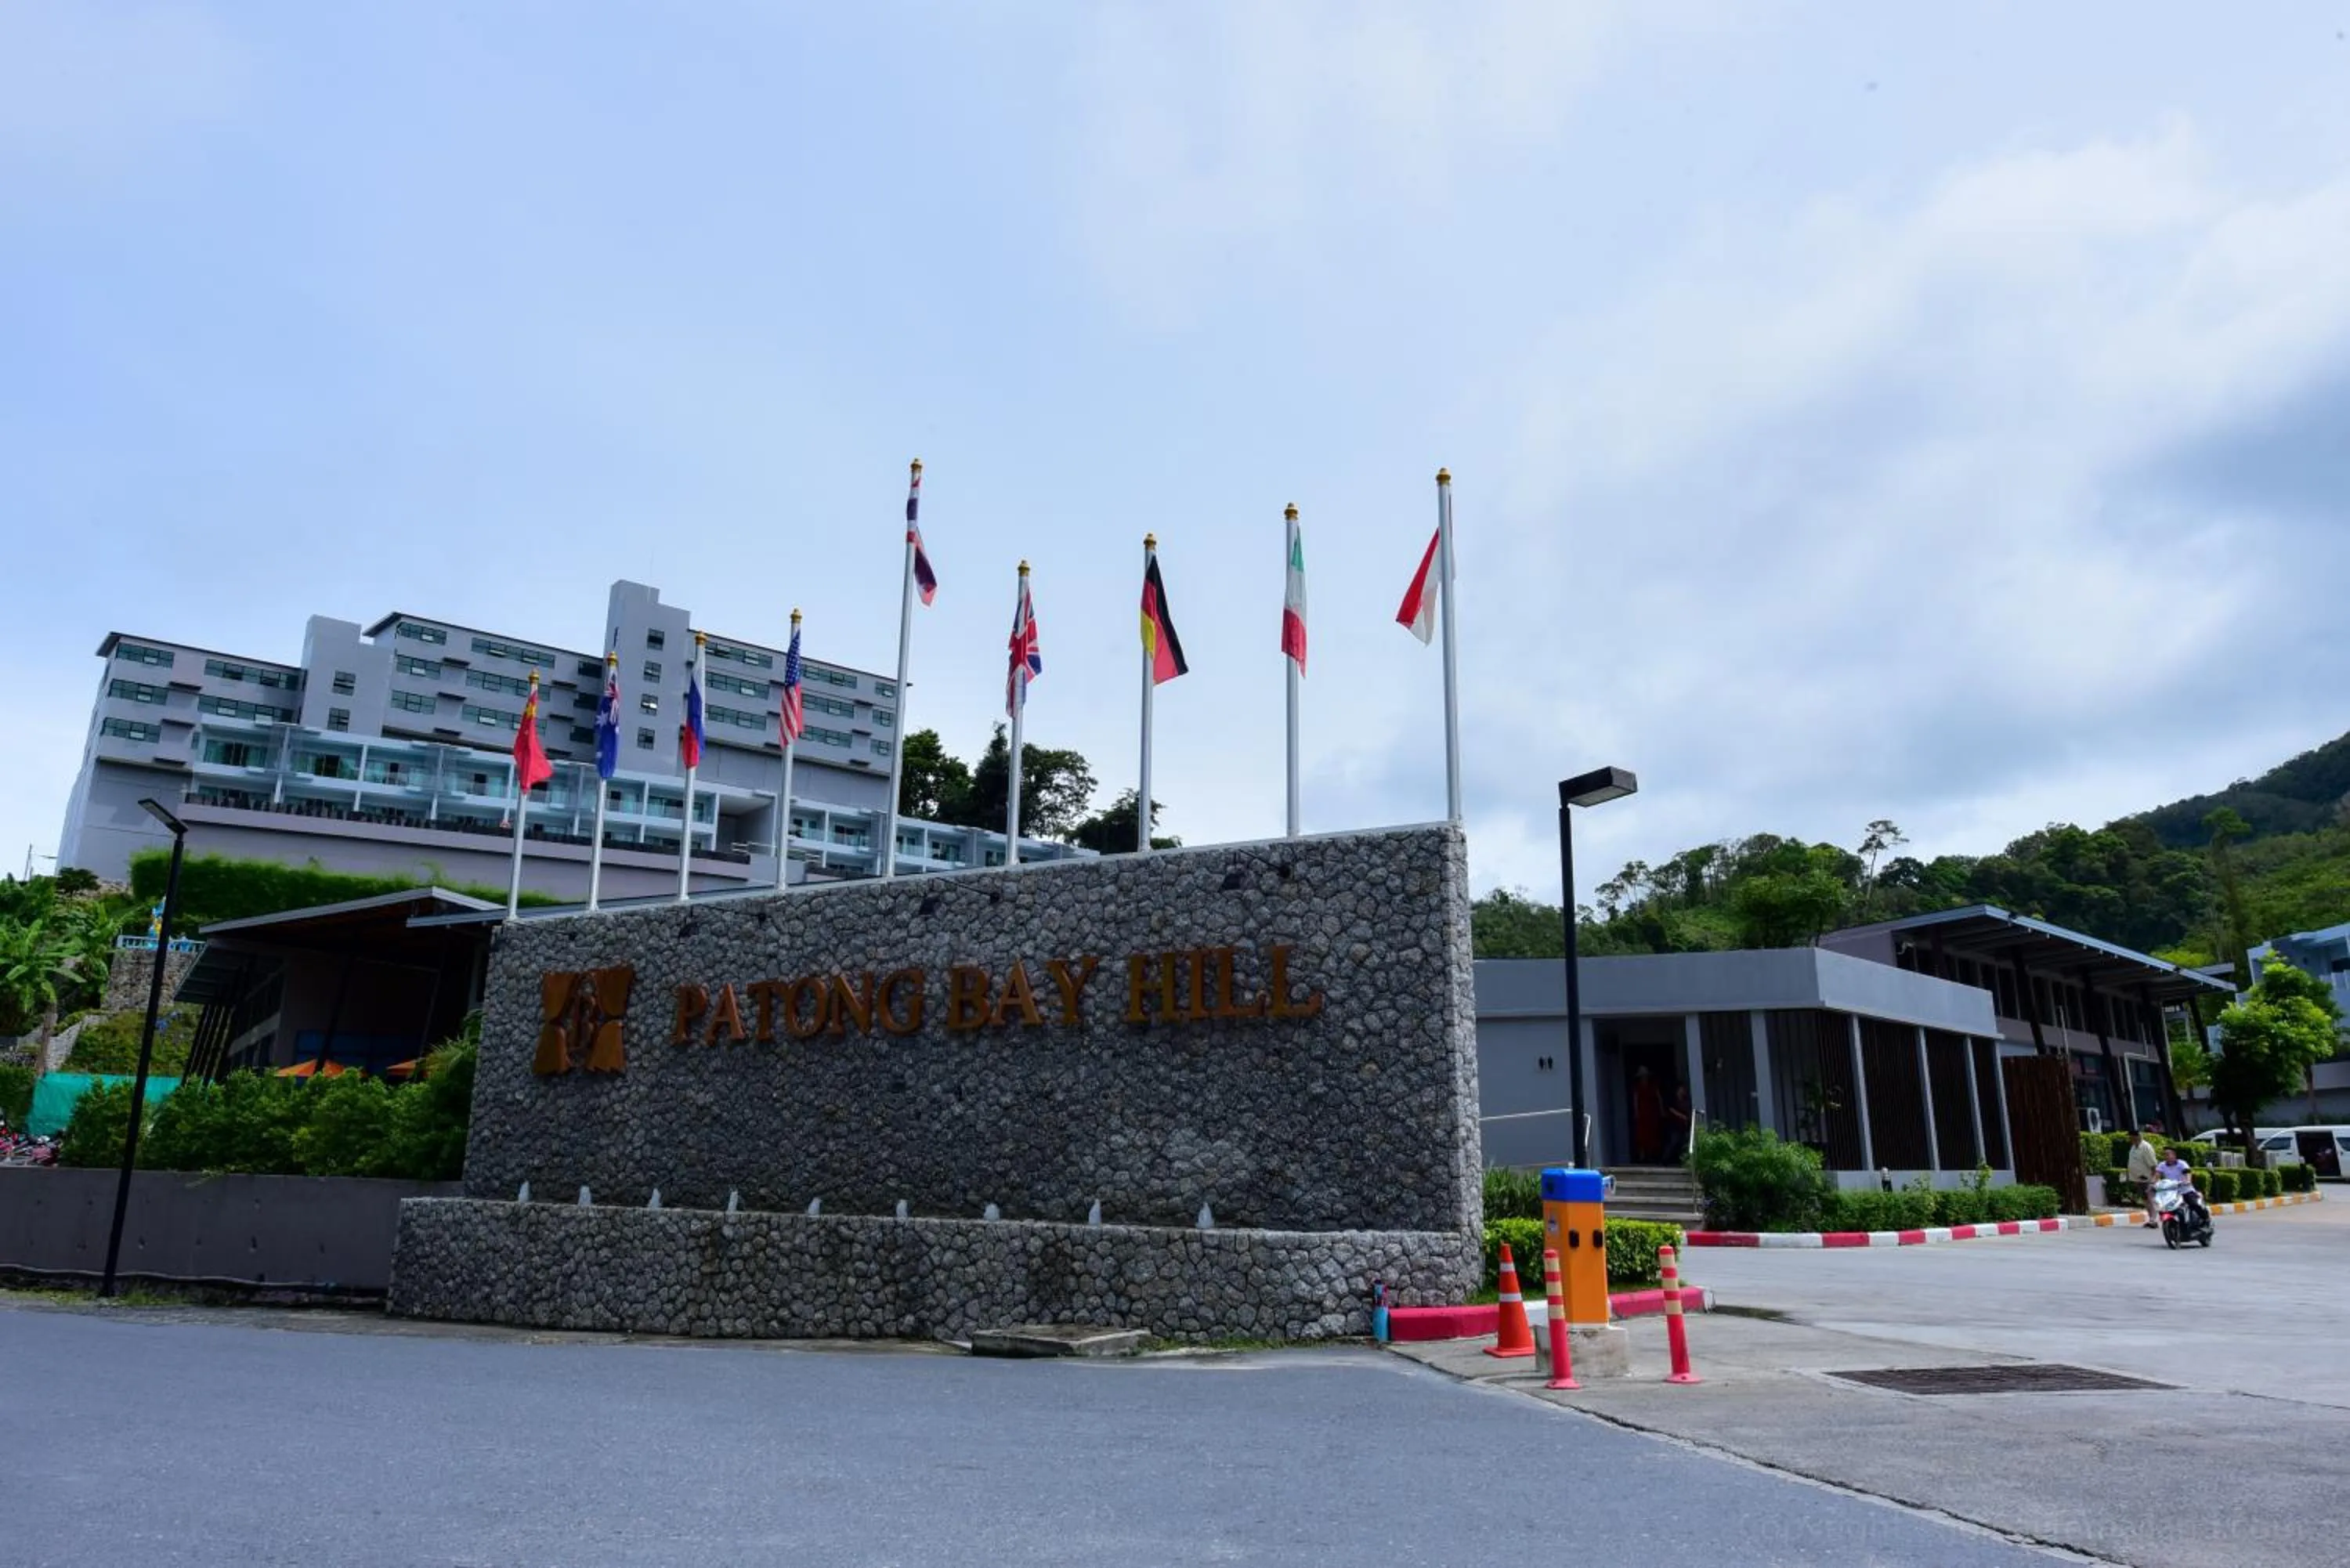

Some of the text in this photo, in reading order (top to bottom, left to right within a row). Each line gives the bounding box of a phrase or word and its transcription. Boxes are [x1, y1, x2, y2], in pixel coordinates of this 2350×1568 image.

[671, 944, 1322, 1046] PATONG BAY HILL
